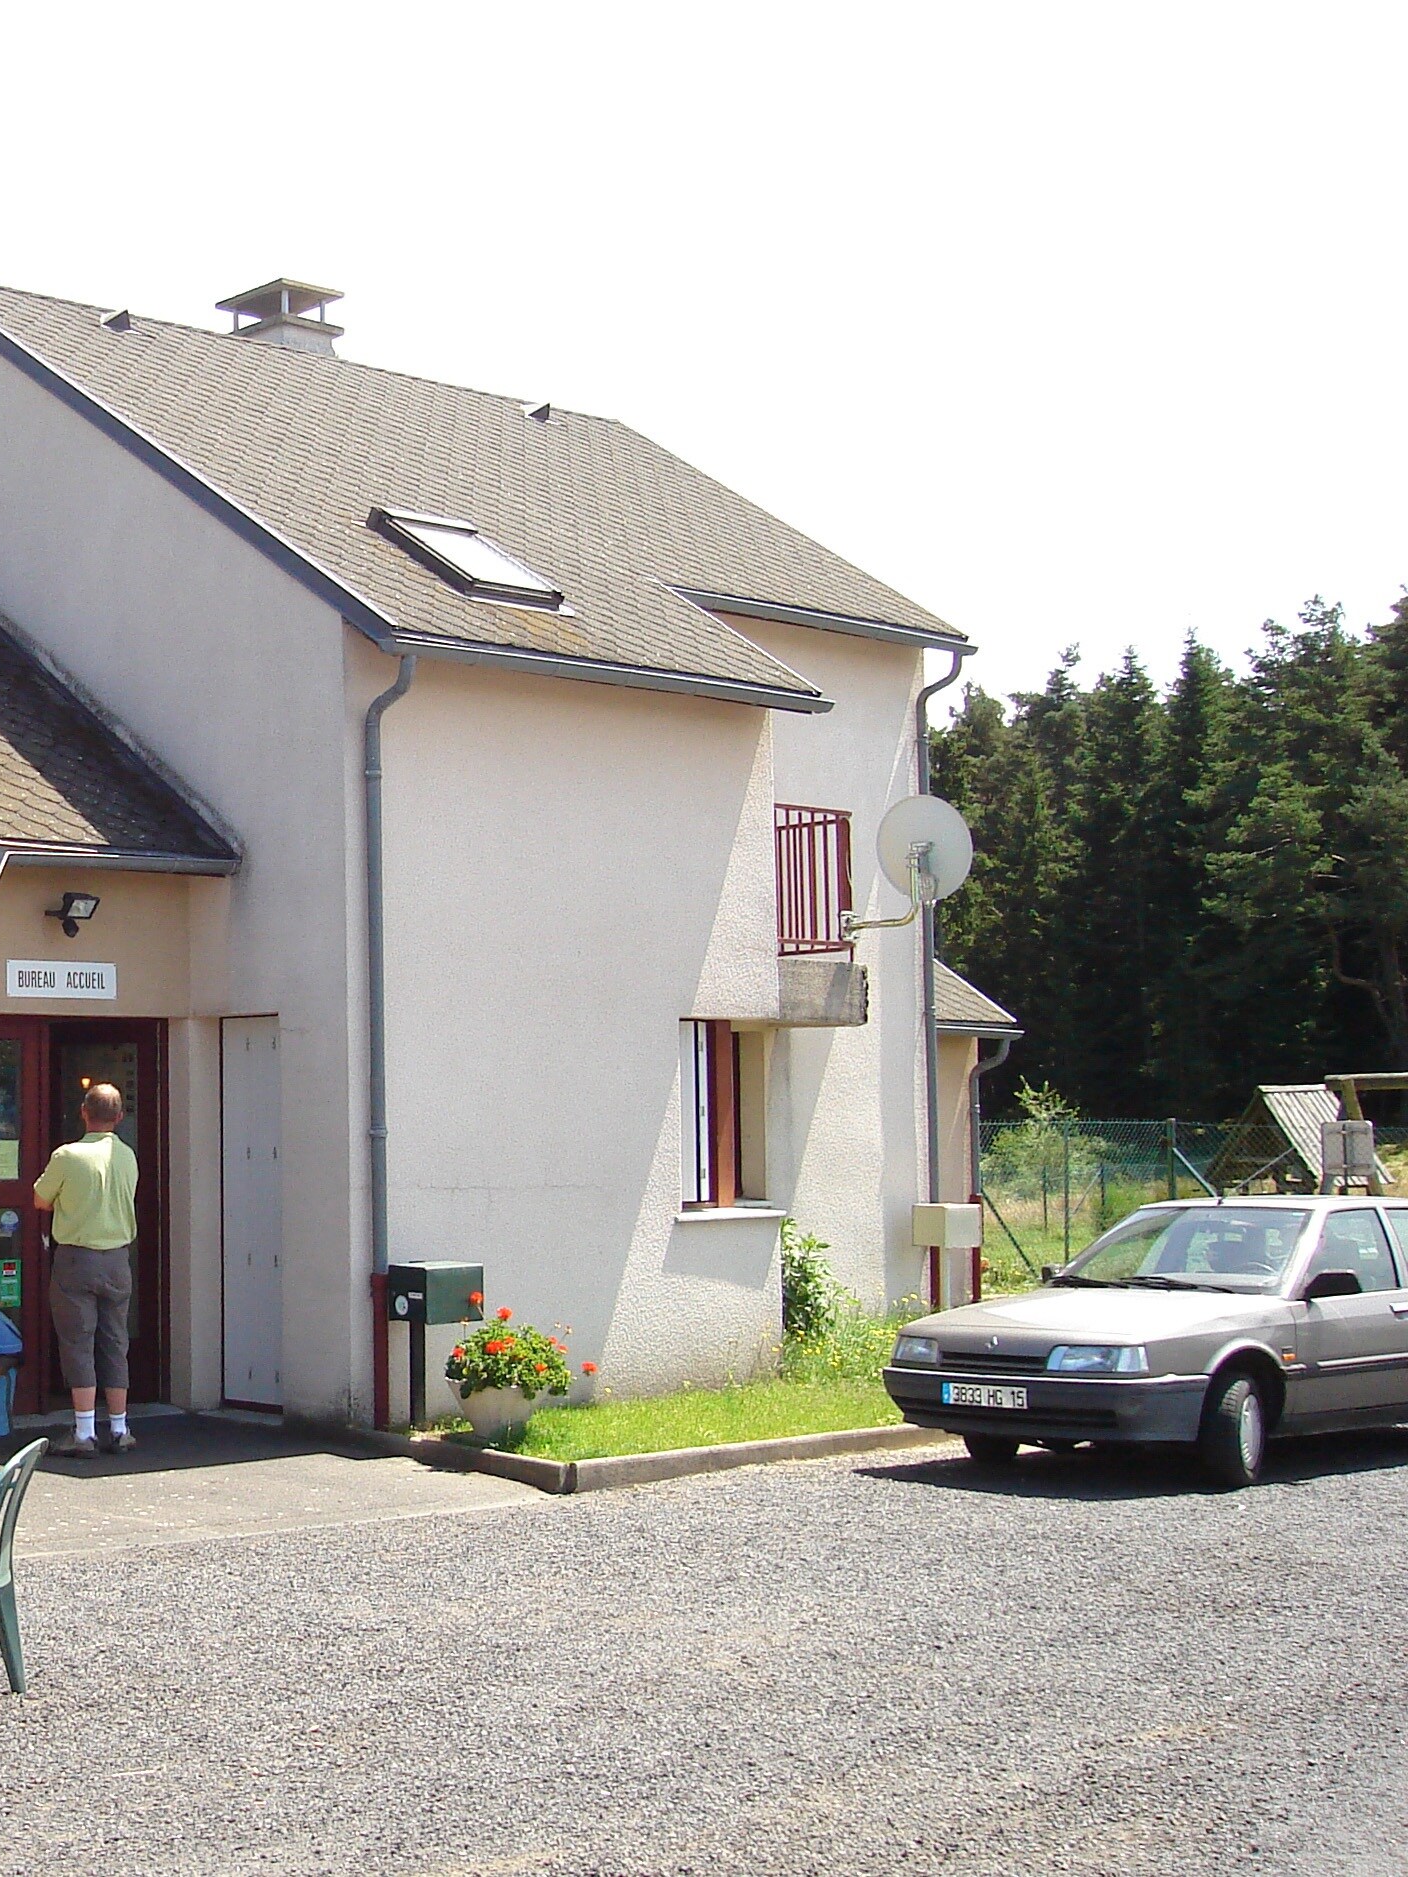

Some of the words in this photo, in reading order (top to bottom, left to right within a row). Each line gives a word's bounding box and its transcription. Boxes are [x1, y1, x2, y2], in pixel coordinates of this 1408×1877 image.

[18, 970, 55, 988] BUREAU
[66, 972, 106, 989] ACCUEIL
[953, 1386, 982, 1404] 3833
[987, 1388, 1003, 1406] HG
[1010, 1390, 1025, 1407] 15
